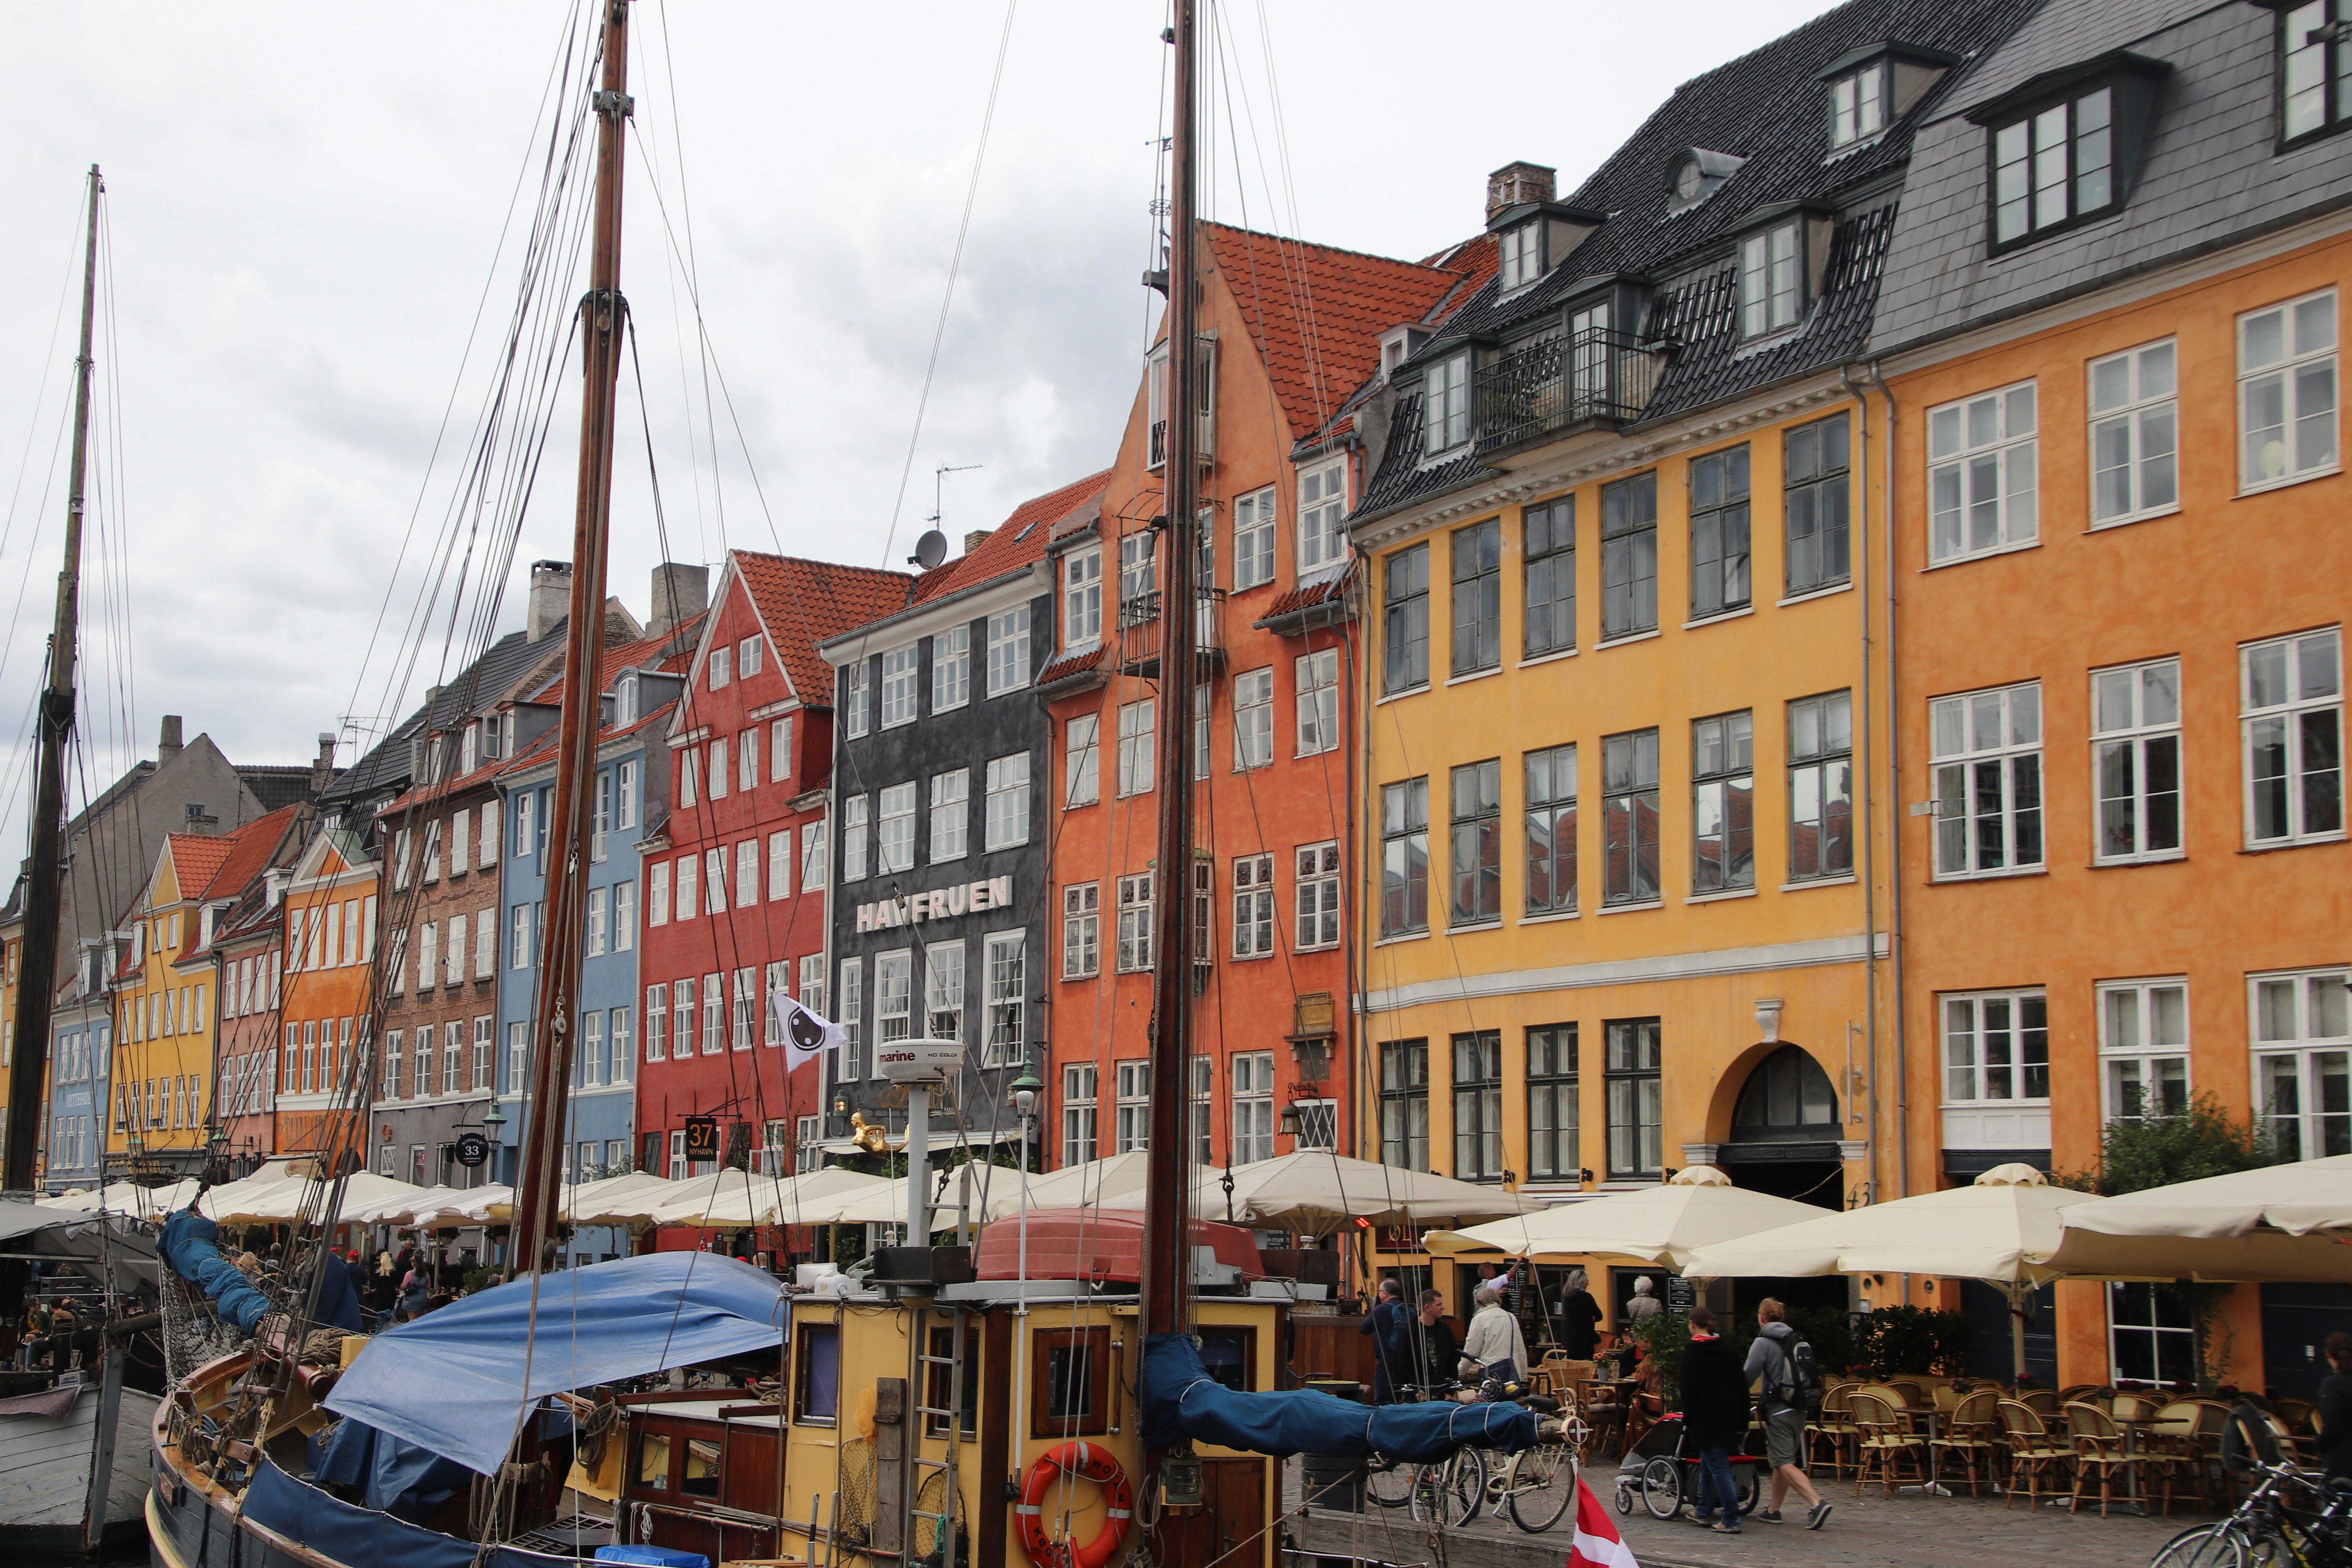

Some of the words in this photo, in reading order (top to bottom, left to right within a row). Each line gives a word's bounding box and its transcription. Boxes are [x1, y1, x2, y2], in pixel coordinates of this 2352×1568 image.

[857, 875, 1012, 933] HAVFRUEN
[66, 1091, 94, 1107] HYTTEFADE
[689, 1123, 713, 1147] 37
[465, 1145, 479, 1156] 33
[1846, 1182, 1870, 1210] 43
[1388, 1225, 1412, 1241] ØL
